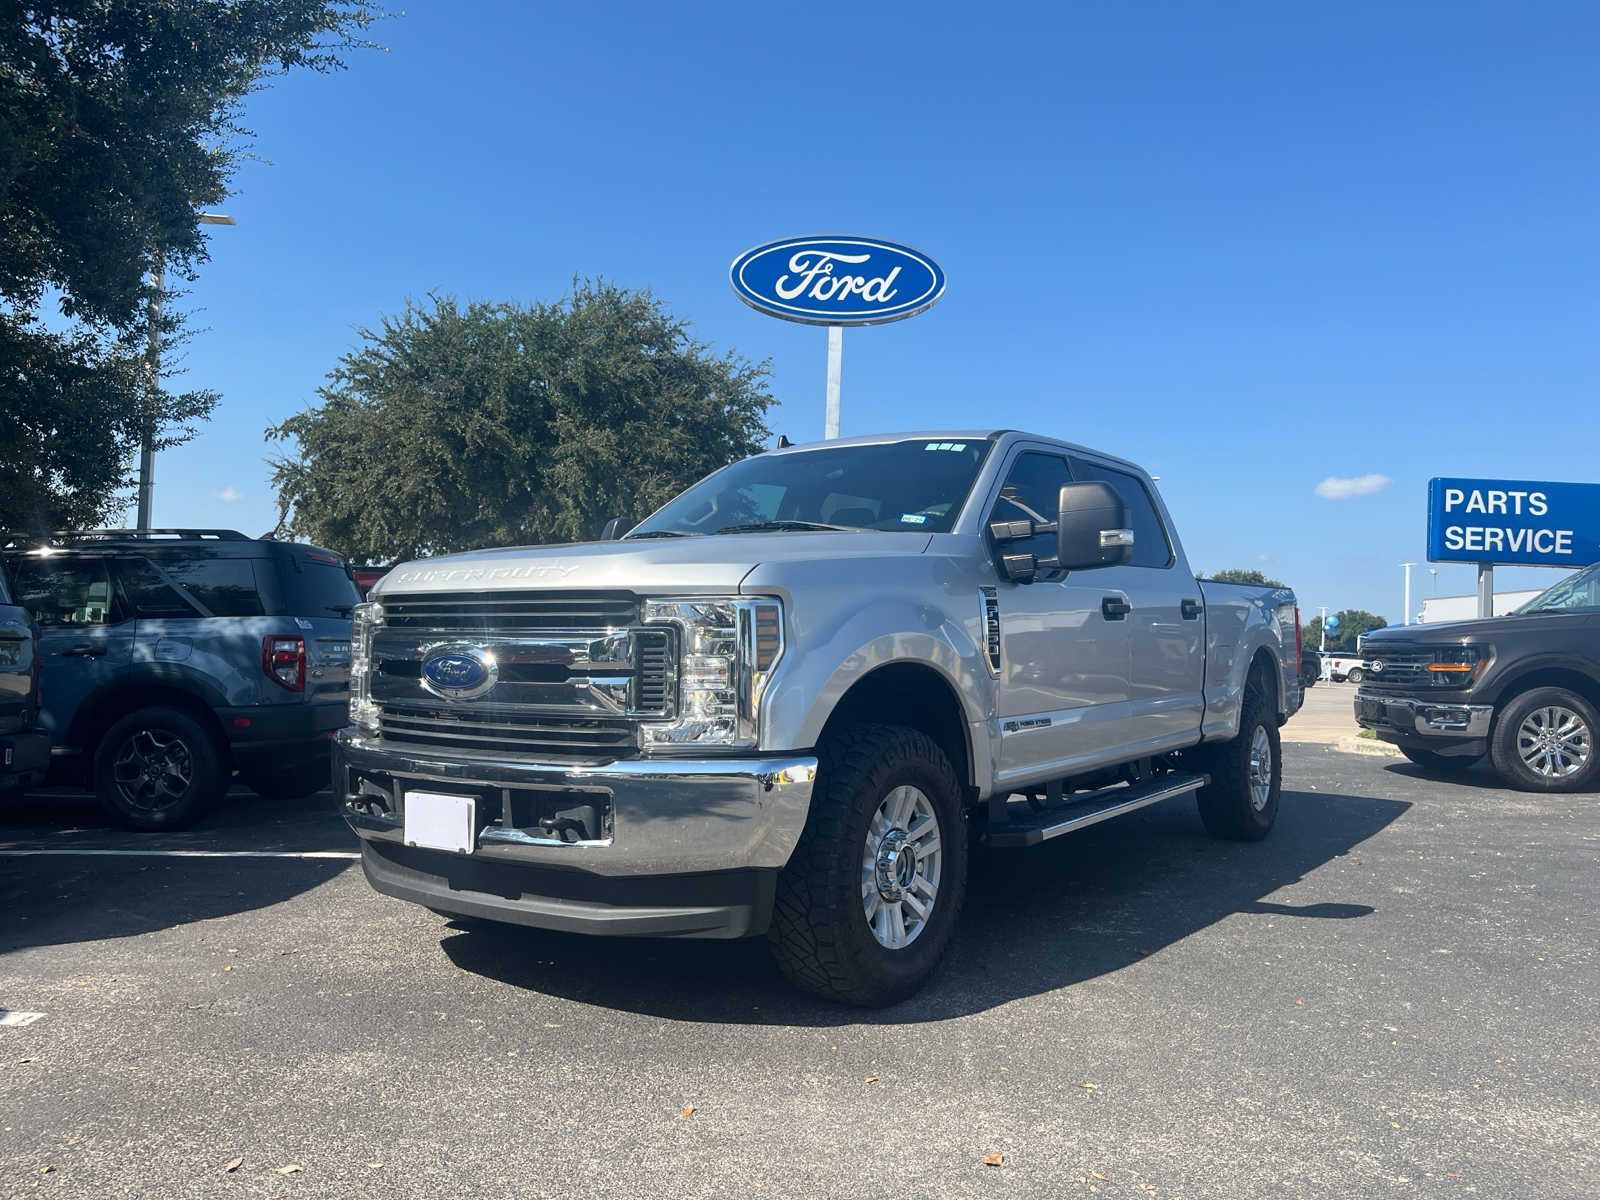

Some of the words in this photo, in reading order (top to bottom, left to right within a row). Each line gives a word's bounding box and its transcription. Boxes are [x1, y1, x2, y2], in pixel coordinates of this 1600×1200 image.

[775, 250, 902, 303] Ford
[1445, 489, 1549, 516] PARTS
[1444, 525, 1574, 555] SERVICE
[489, 564, 580, 580] DUTY
